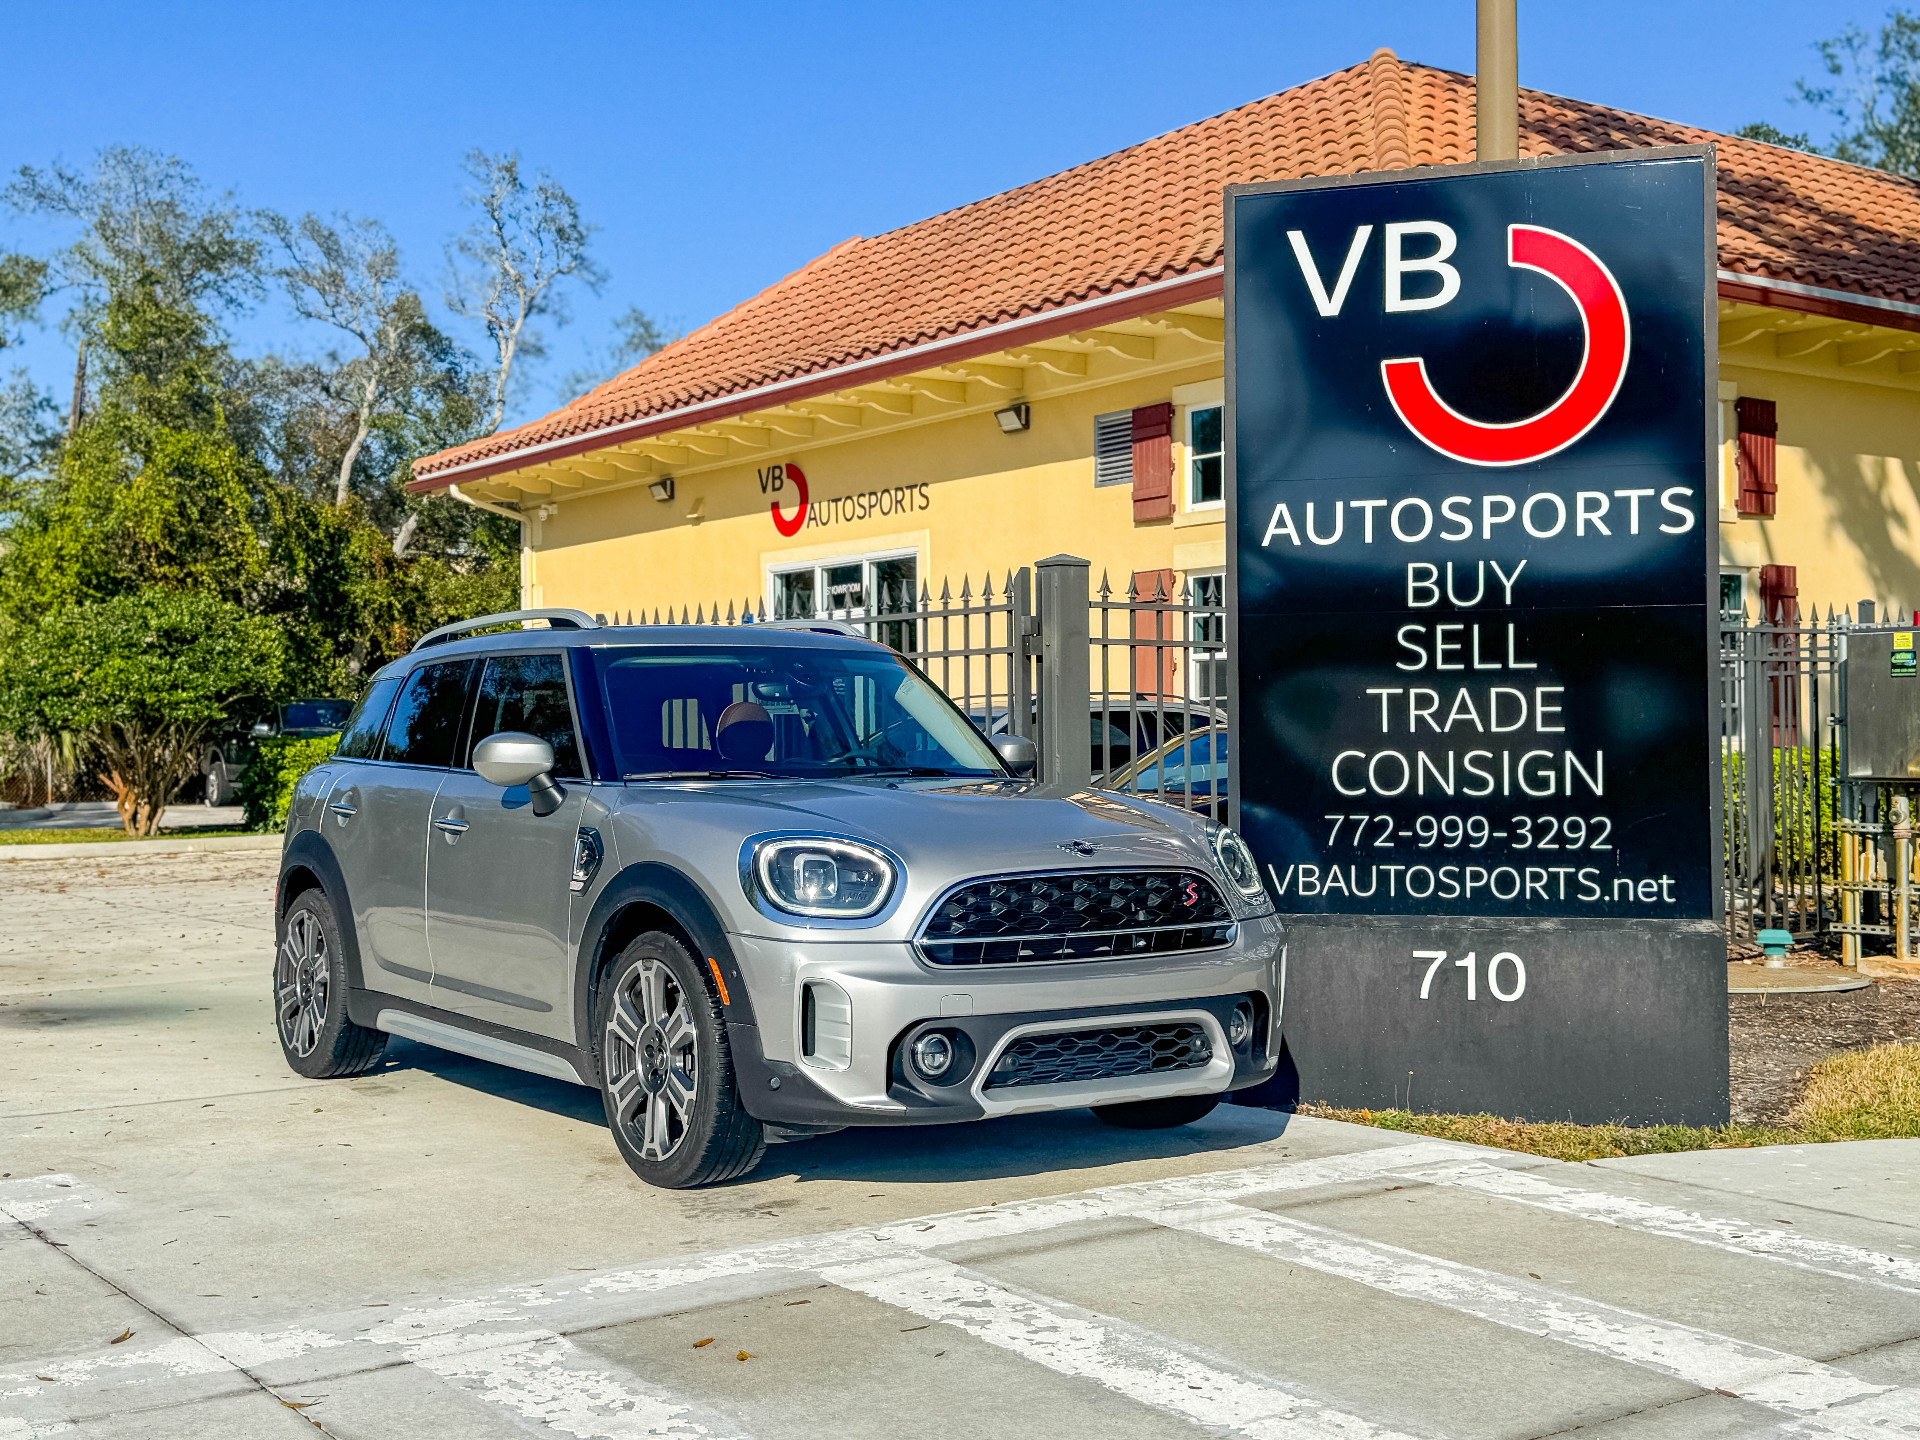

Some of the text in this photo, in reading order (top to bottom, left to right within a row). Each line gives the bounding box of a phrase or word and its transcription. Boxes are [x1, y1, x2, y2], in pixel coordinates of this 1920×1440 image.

[1286, 221, 1462, 317] VB
[757, 465, 784, 494] VB
[806, 482, 930, 529] AUTOSPORTS
[1261, 486, 1695, 547] AUTOSPORTS
[1407, 560, 1528, 608] BUY
[1395, 623, 1538, 671] SELL
[1366, 687, 1566, 733] TRADE
[1331, 750, 1604, 796] CONSIGN
[1324, 815, 1613, 850] 772-999-3292
[1183, 882, 1198, 907] S
[1267, 864, 1677, 903] VBAUTOSPORTS.net
[1413, 946, 1527, 1003] 710
